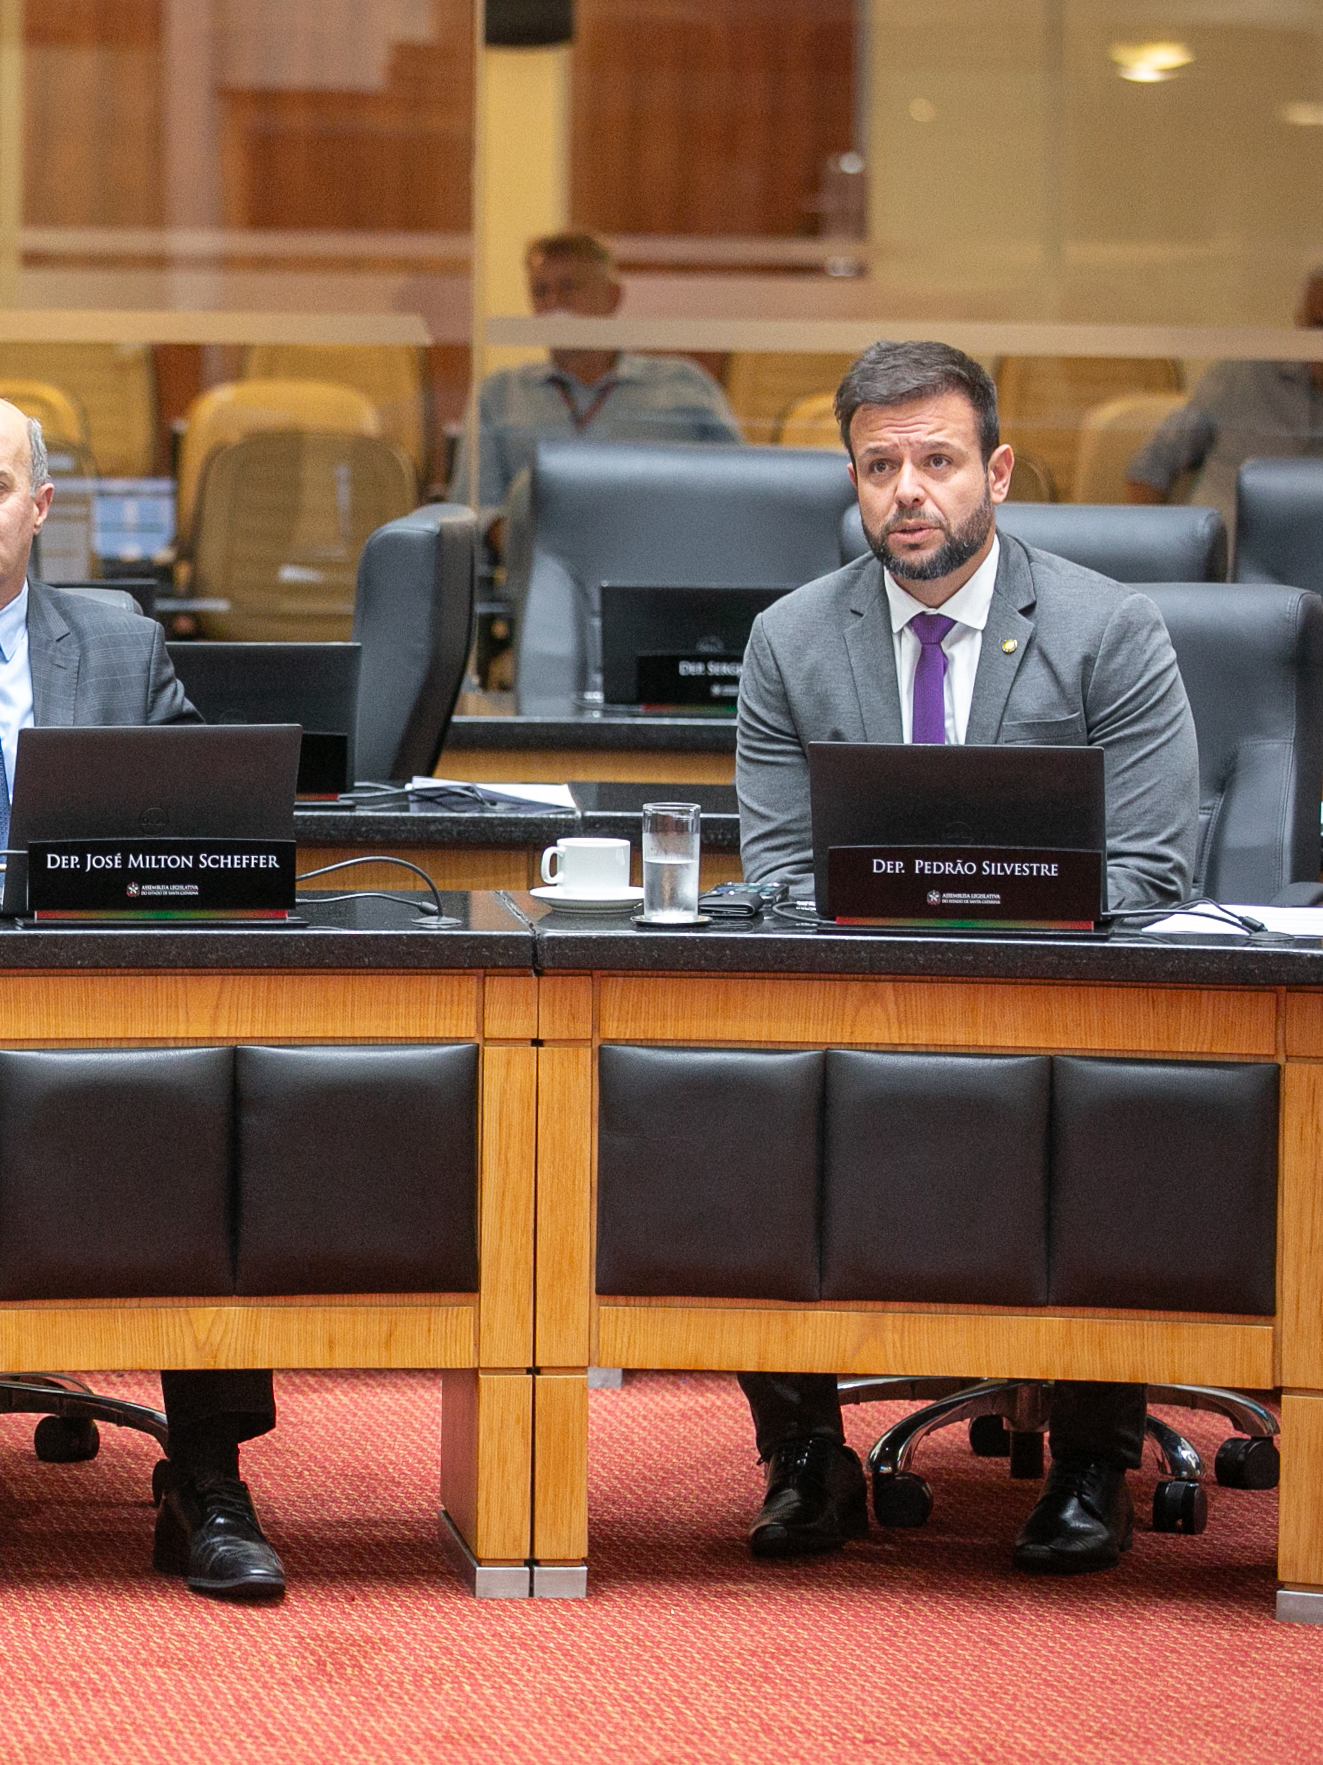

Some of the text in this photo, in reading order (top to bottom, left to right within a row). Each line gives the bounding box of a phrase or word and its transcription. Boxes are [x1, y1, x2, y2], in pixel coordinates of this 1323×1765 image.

[47, 853, 280, 872] DEP. JOSÉ MILTON SCHEFFER
[873, 859, 1058, 876] DEP. PEDRÃO SILVESTRE
